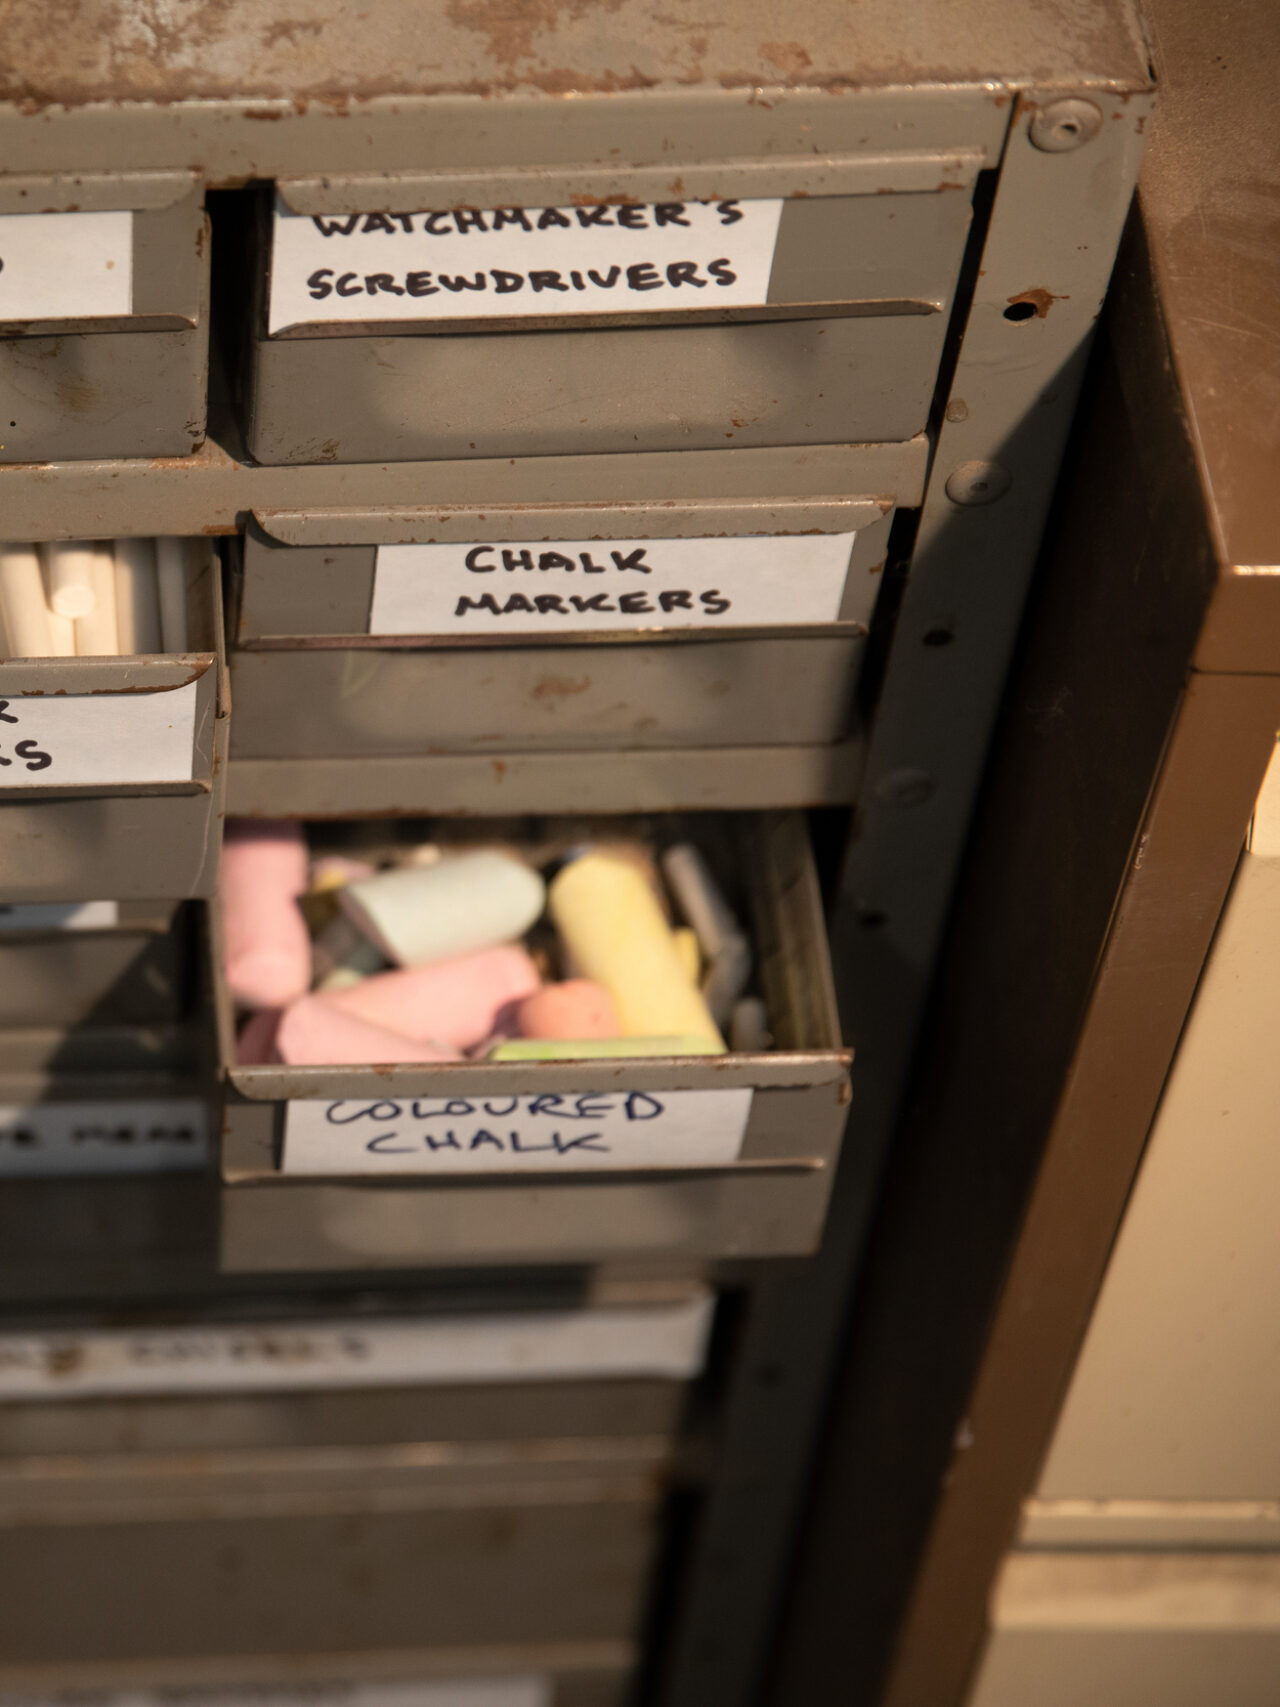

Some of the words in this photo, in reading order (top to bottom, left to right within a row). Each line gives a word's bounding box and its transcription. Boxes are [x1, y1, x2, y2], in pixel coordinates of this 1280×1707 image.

[311, 199, 744, 237] WATCHMAKER'S
[306, 257, 738, 300] SCREWDRIVERS
[464, 545, 652, 574] CHALK
[454, 589, 731, 617] MARKERS
[325, 1090, 664, 1126] COLOURED
[365, 1130, 611, 1154] CHALK
